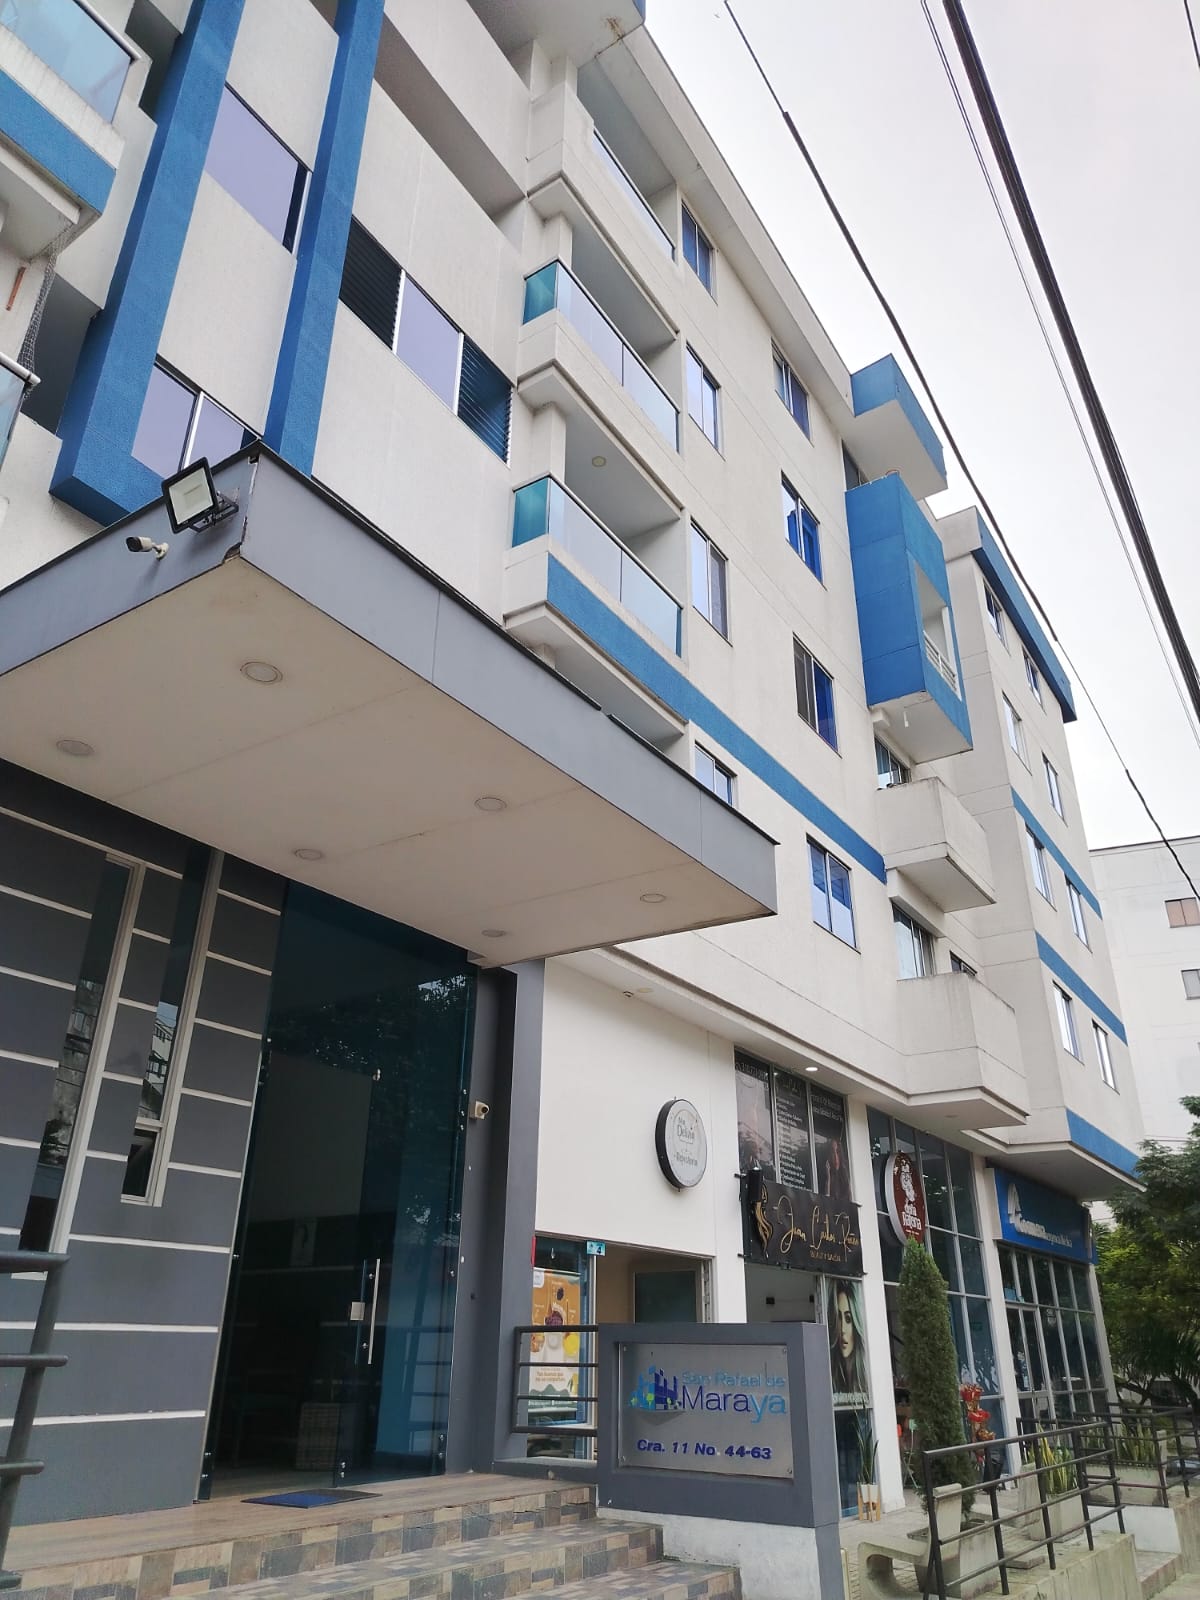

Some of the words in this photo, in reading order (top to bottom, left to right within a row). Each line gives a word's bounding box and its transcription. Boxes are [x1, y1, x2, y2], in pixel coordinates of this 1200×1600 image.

[776, 1194, 807, 1254] Juan
[682, 1371, 710, 1385] San
[715, 1372, 762, 1388] Rafael
[682, 1385, 787, 1423] Maraya
[637, 1439, 665, 1452] Cra.
[672, 1441, 688, 1453] 11
[694, 1442, 719, 1456] No.
[724, 1445, 772, 1460] 44-63
